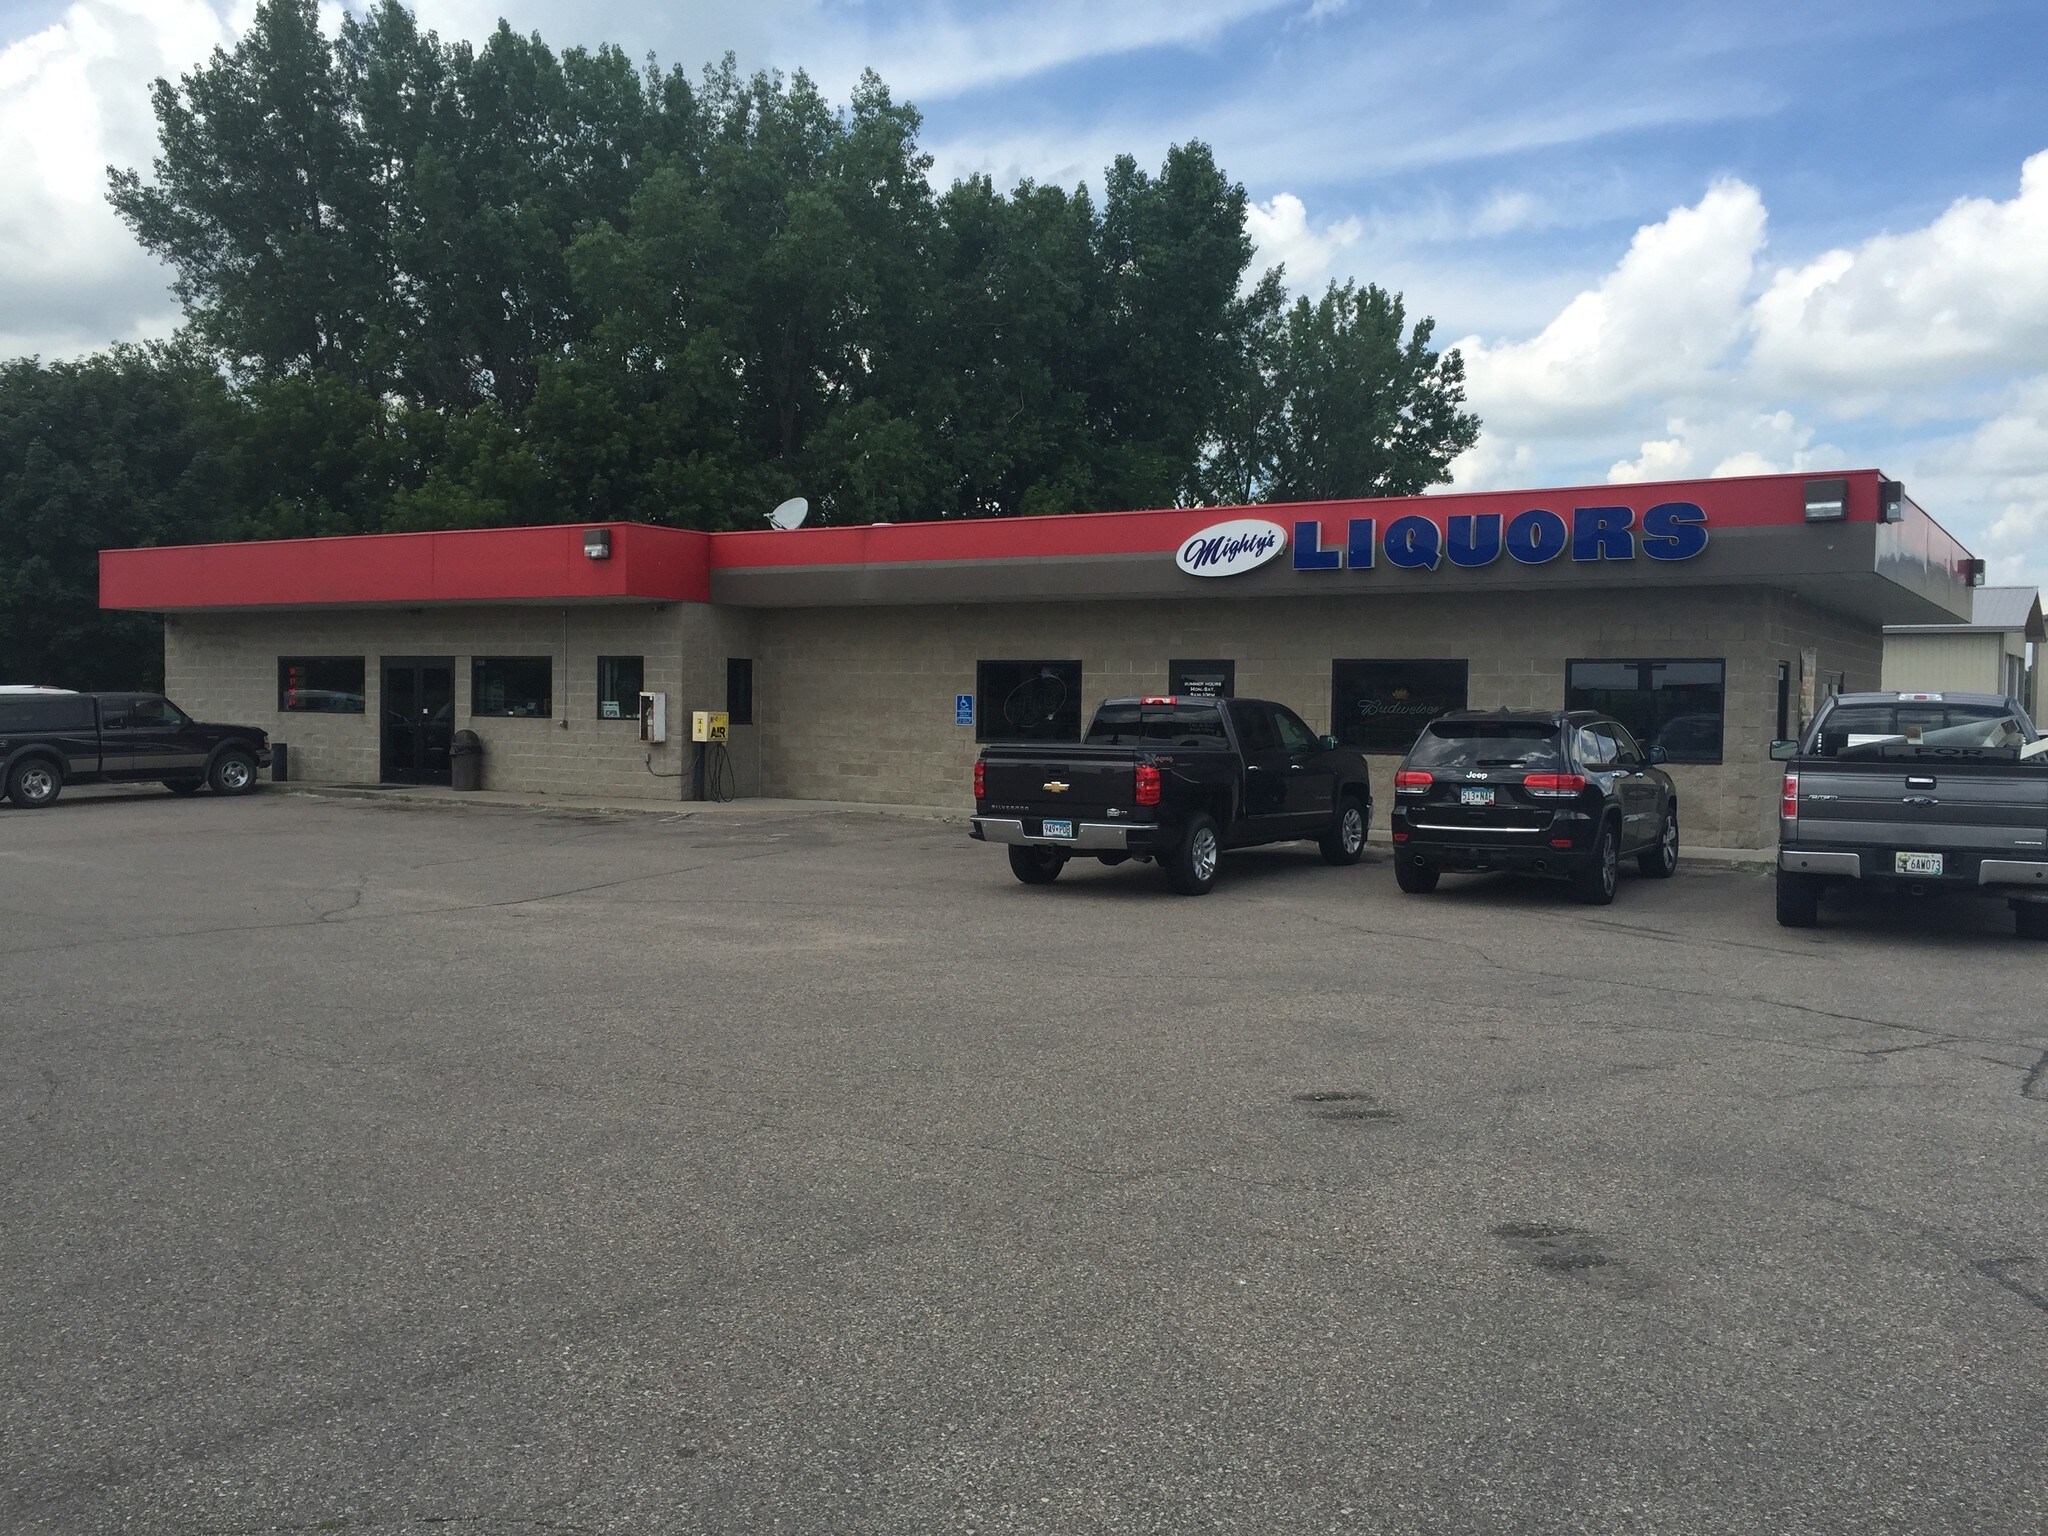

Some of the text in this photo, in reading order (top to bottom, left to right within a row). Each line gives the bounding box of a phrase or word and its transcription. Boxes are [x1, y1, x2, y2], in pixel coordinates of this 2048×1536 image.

[1183, 502, 1708, 571] Mighty's LIQUORS
[1357, 699, 1444, 716] Budweiser
[710, 727, 726, 738] AIR
[1914, 748, 1984, 756] FOR
[1465, 770, 1488, 781] Jeep
